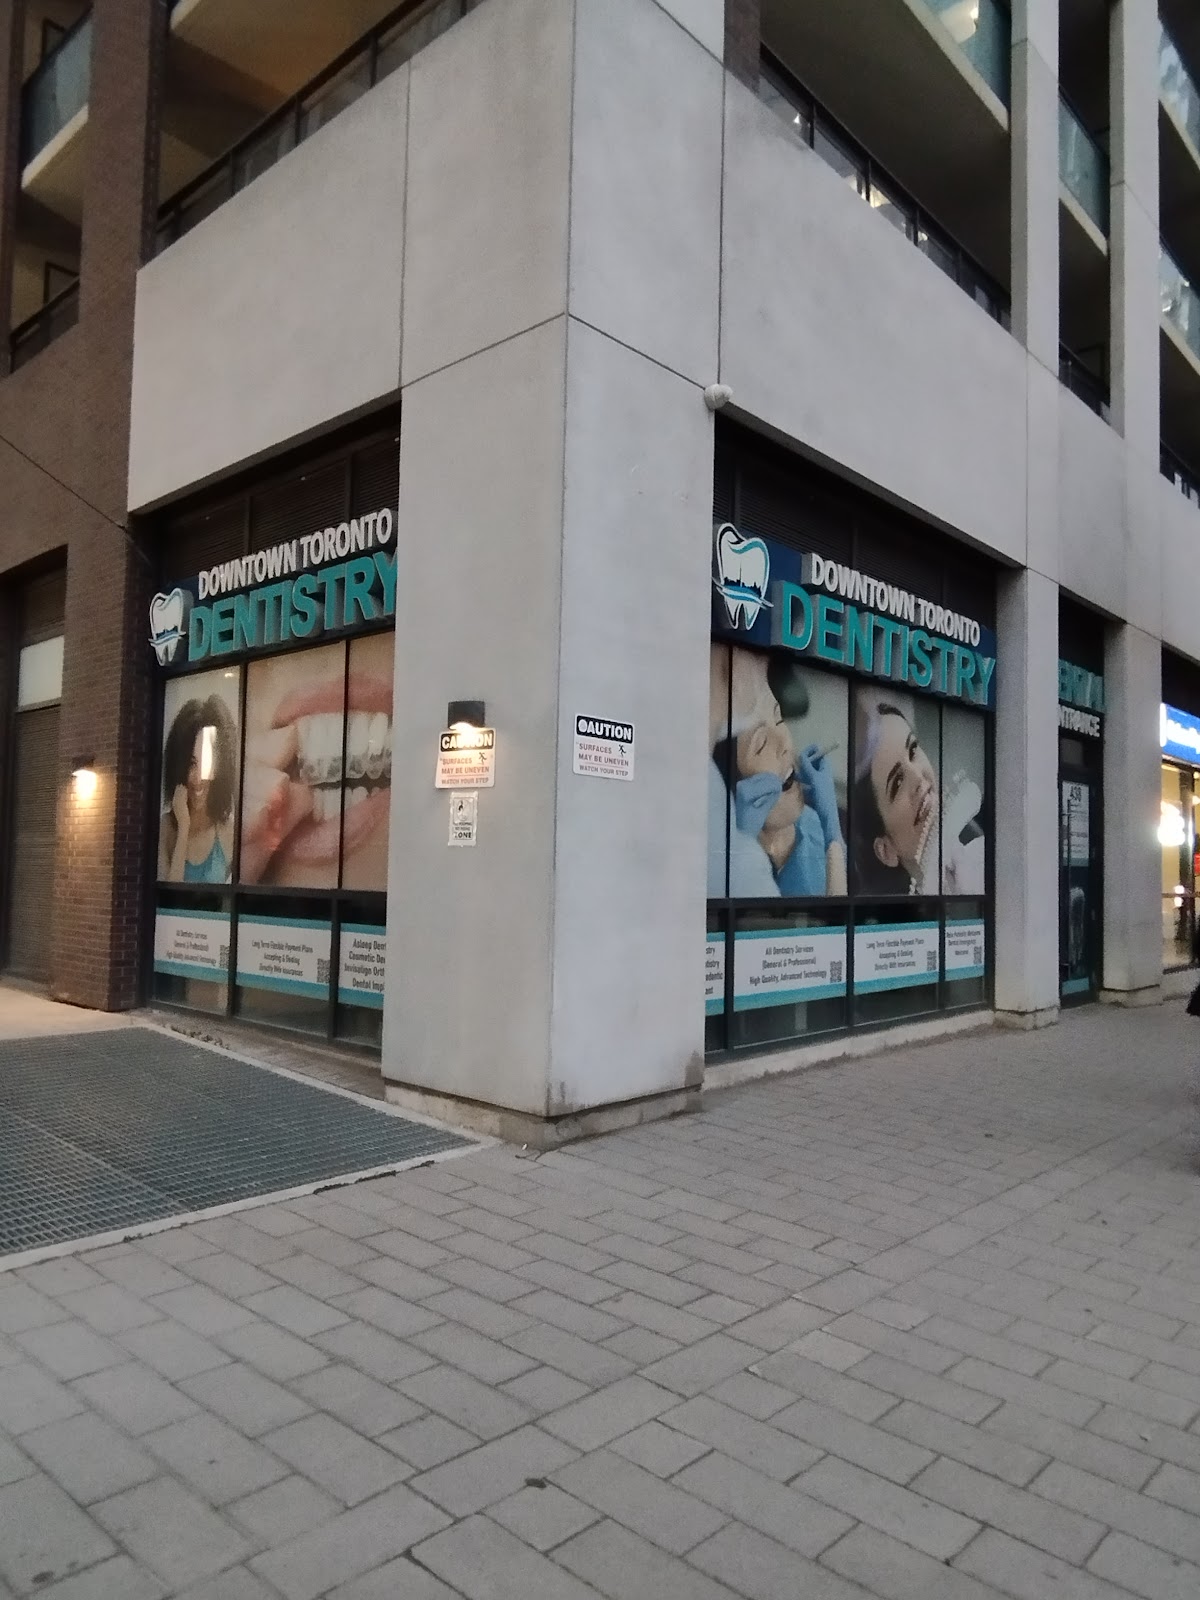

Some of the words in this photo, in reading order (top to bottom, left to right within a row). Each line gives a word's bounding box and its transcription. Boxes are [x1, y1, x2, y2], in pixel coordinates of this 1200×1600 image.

[198, 539, 298, 600] DOWNTOWN
[300, 508, 393, 568] TORONTO
[188, 547, 399, 662] DENTISTRY
[811, 552, 916, 624] DOWNTOWN
[916, 597, 981, 648] TORONTO
[780, 580, 996, 706] DENTISTRY
[441, 733, 493, 750] CAON
[579, 743, 612, 754] SURFACES
[442, 757, 473, 766] SURFACES
[578, 752, 593, 761] MAY
[594, 755, 602, 763] BE
[604, 757, 629, 767] UNEVEN
[441, 767, 453, 775] MAY
[465, 766, 490, 774] UNEVEN
[579, 765, 598, 773] WATCH
[599, 767, 614, 775] YOUR
[349, 950, 375, 963] Cosmetic
[353, 977, 371, 989] Dental
